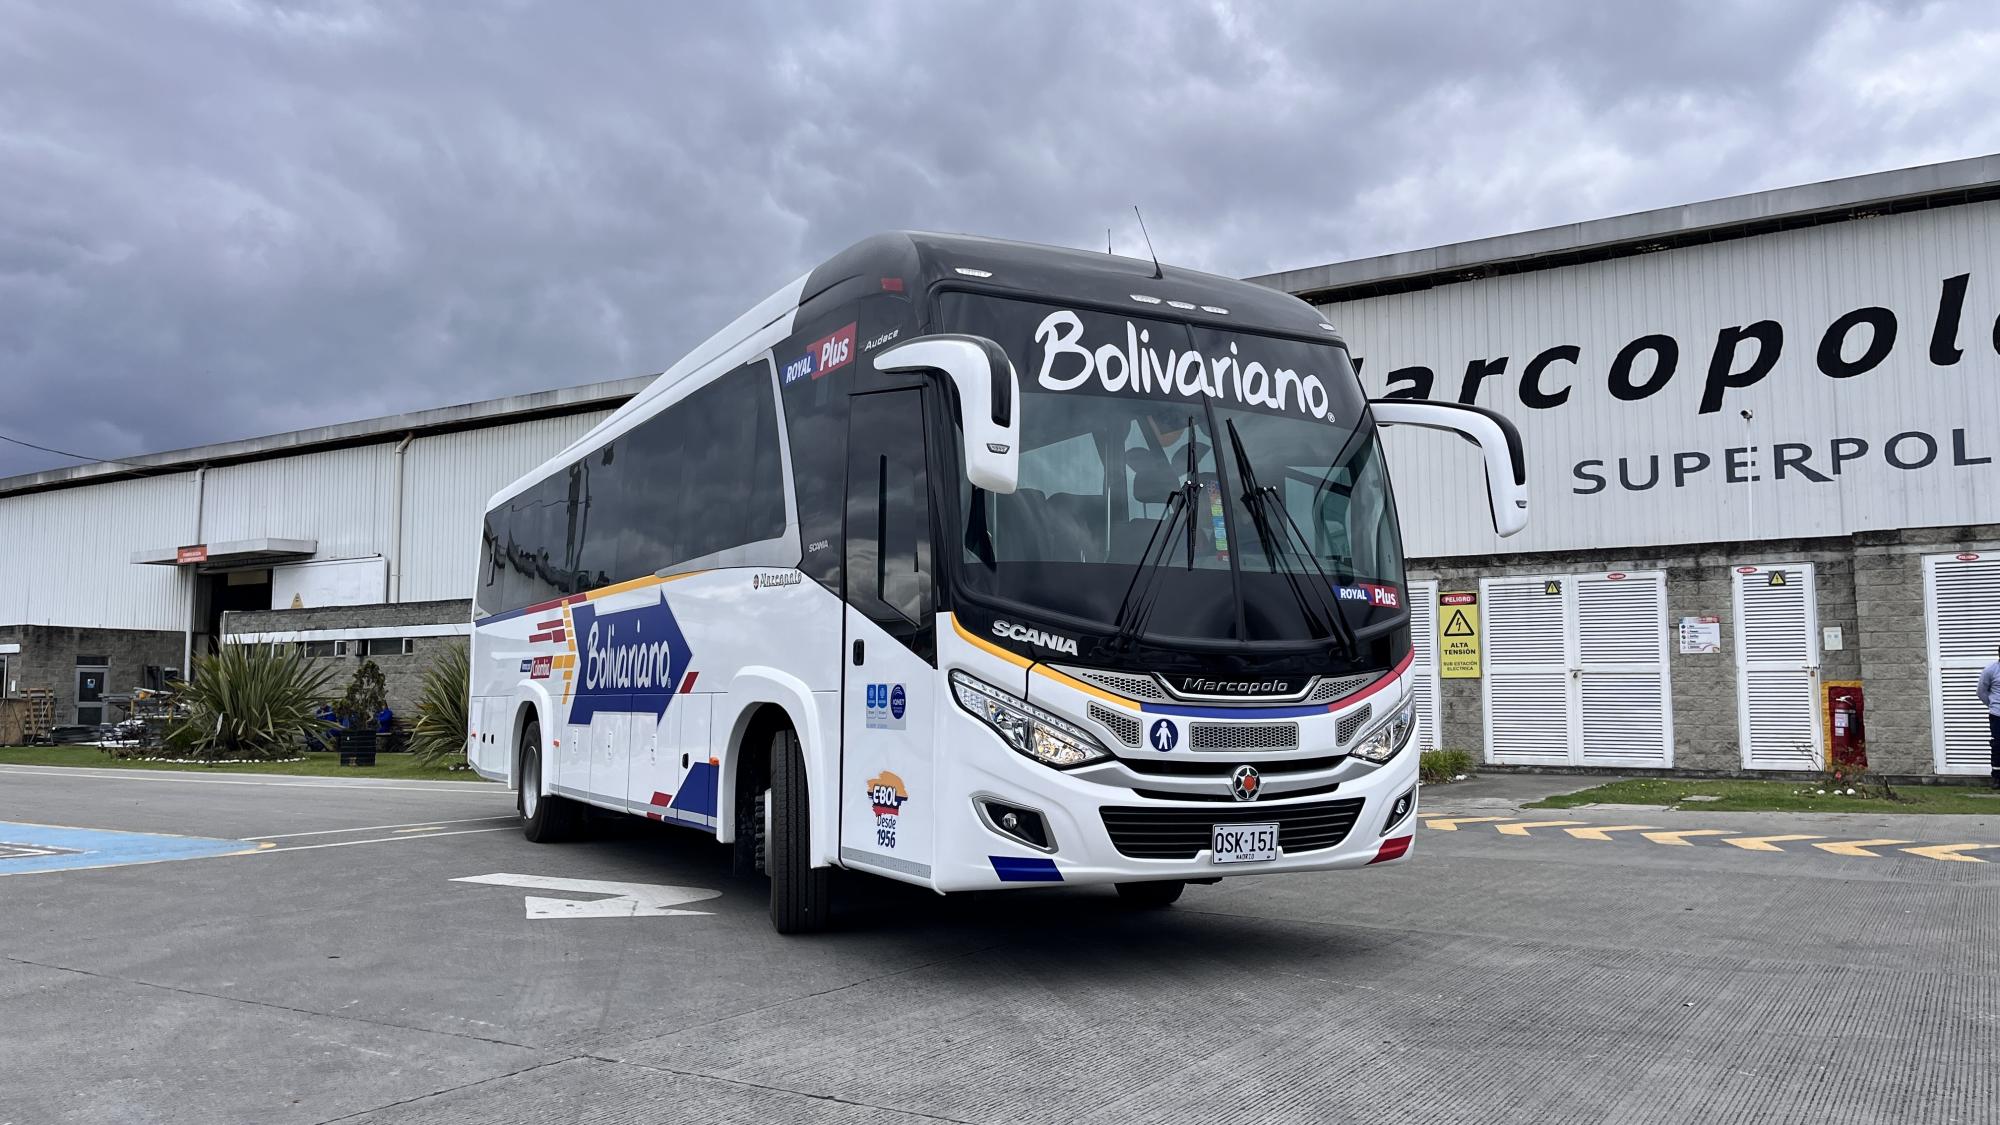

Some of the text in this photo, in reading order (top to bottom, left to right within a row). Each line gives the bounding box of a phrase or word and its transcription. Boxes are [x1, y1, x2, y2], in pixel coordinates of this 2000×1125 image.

[864, 329, 899, 351] Audace
[1352, 272, 2000, 415] arcopol
[785, 336, 849, 384] ROYAL Plus
[1572, 428, 1992, 494] SUPERPOL
[808, 540, 829, 553] SCANIA
[1340, 588, 1396, 606] ROYAL Plus
[991, 619, 1078, 657] SCANIA
[1182, 677, 1288, 695] Marcopolo
[876, 815, 896, 829] Desde
[876, 828, 896, 848] 1956
